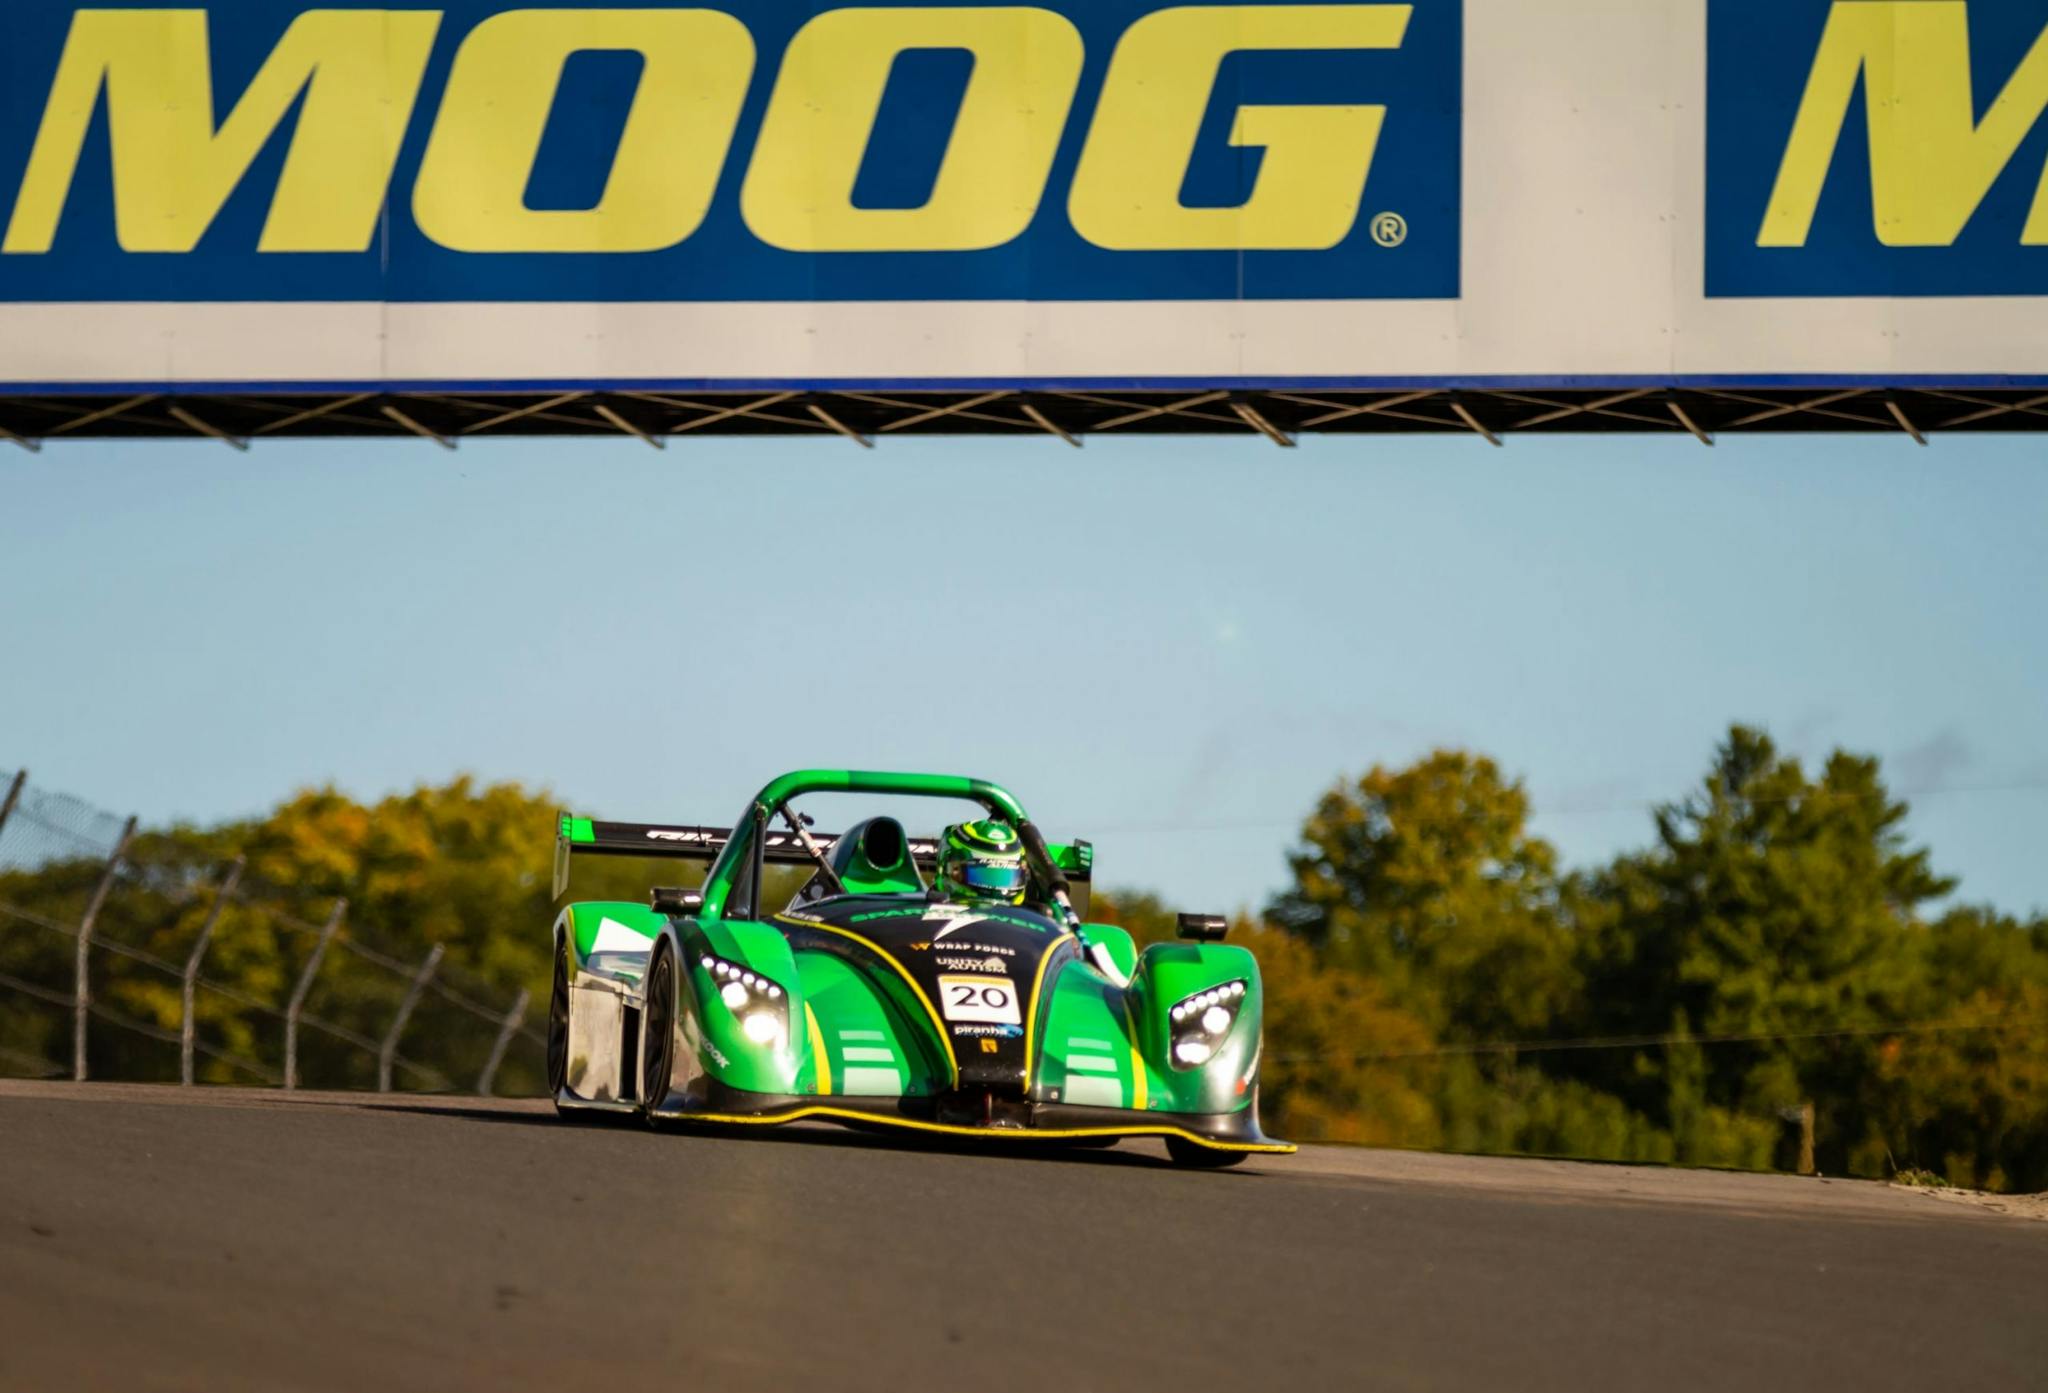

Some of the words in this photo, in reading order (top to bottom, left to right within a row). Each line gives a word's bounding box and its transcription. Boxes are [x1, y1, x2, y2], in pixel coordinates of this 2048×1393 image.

[2, 4, 1413, 253] MOOG
[934, 942, 971, 951] WRAP
[975, 944, 1016, 956] FORCE
[951, 985, 1009, 1009] 20
[954, 1024, 1008, 1036] piranha
